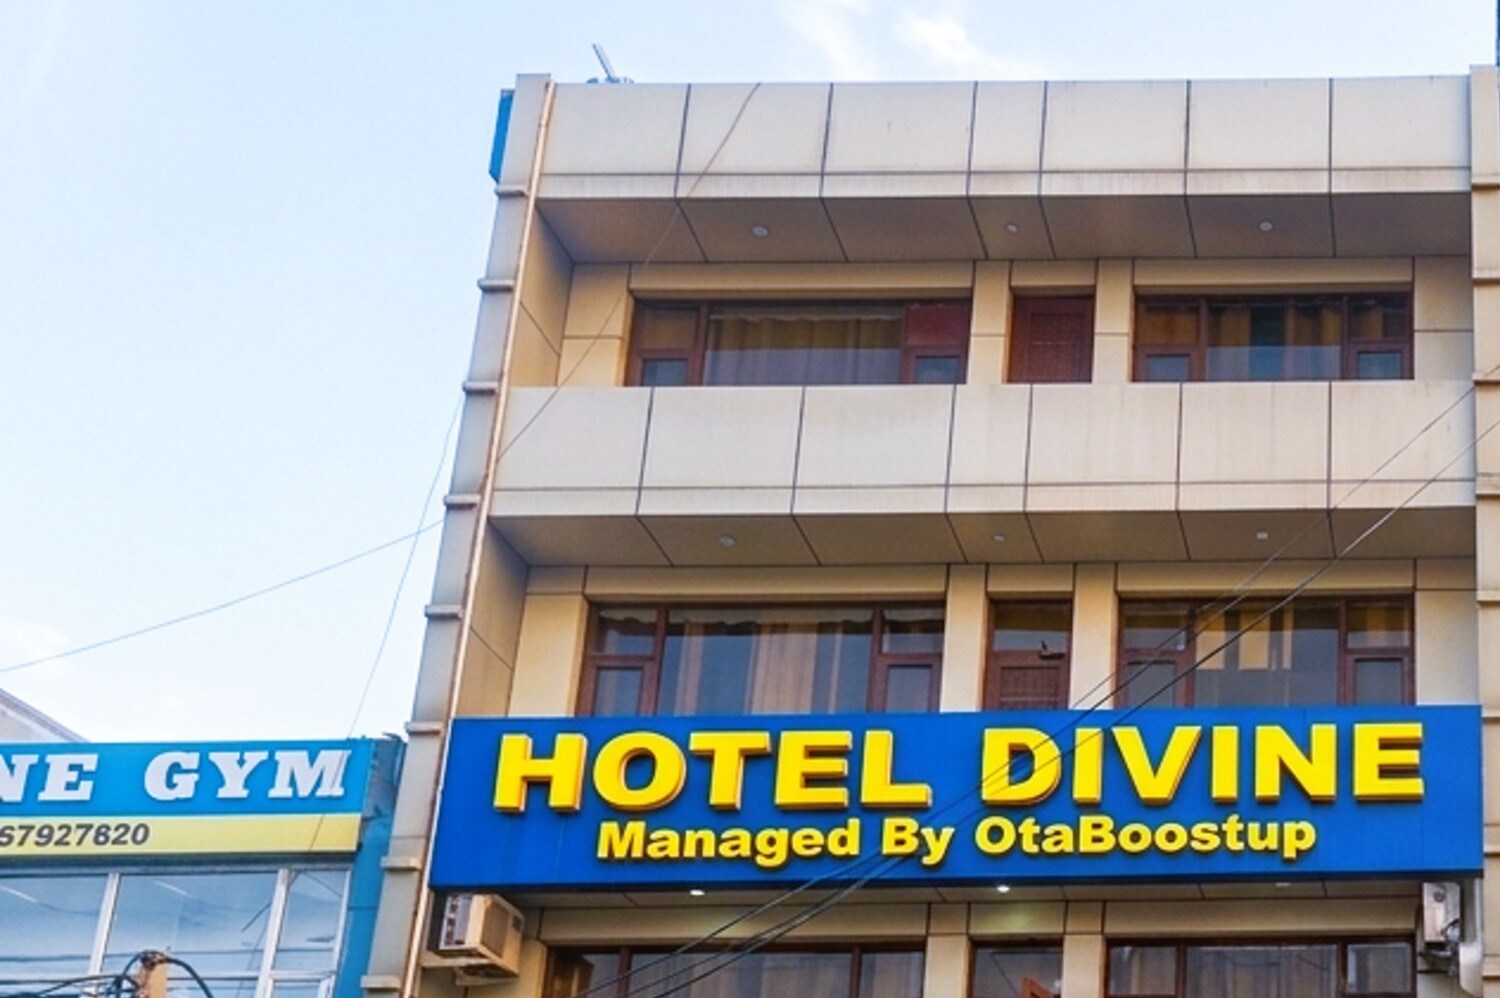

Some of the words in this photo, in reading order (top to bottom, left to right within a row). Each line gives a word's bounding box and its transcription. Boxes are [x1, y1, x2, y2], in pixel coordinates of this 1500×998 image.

[144, 750, 351, 800] GYM
[493, 729, 933, 812] HOTEL
[980, 722, 1425, 802] DIVINE
[596, 818, 861, 868] Managed
[881, 816, 951, 866] By
[975, 814, 1317, 859] OtaBoostup
